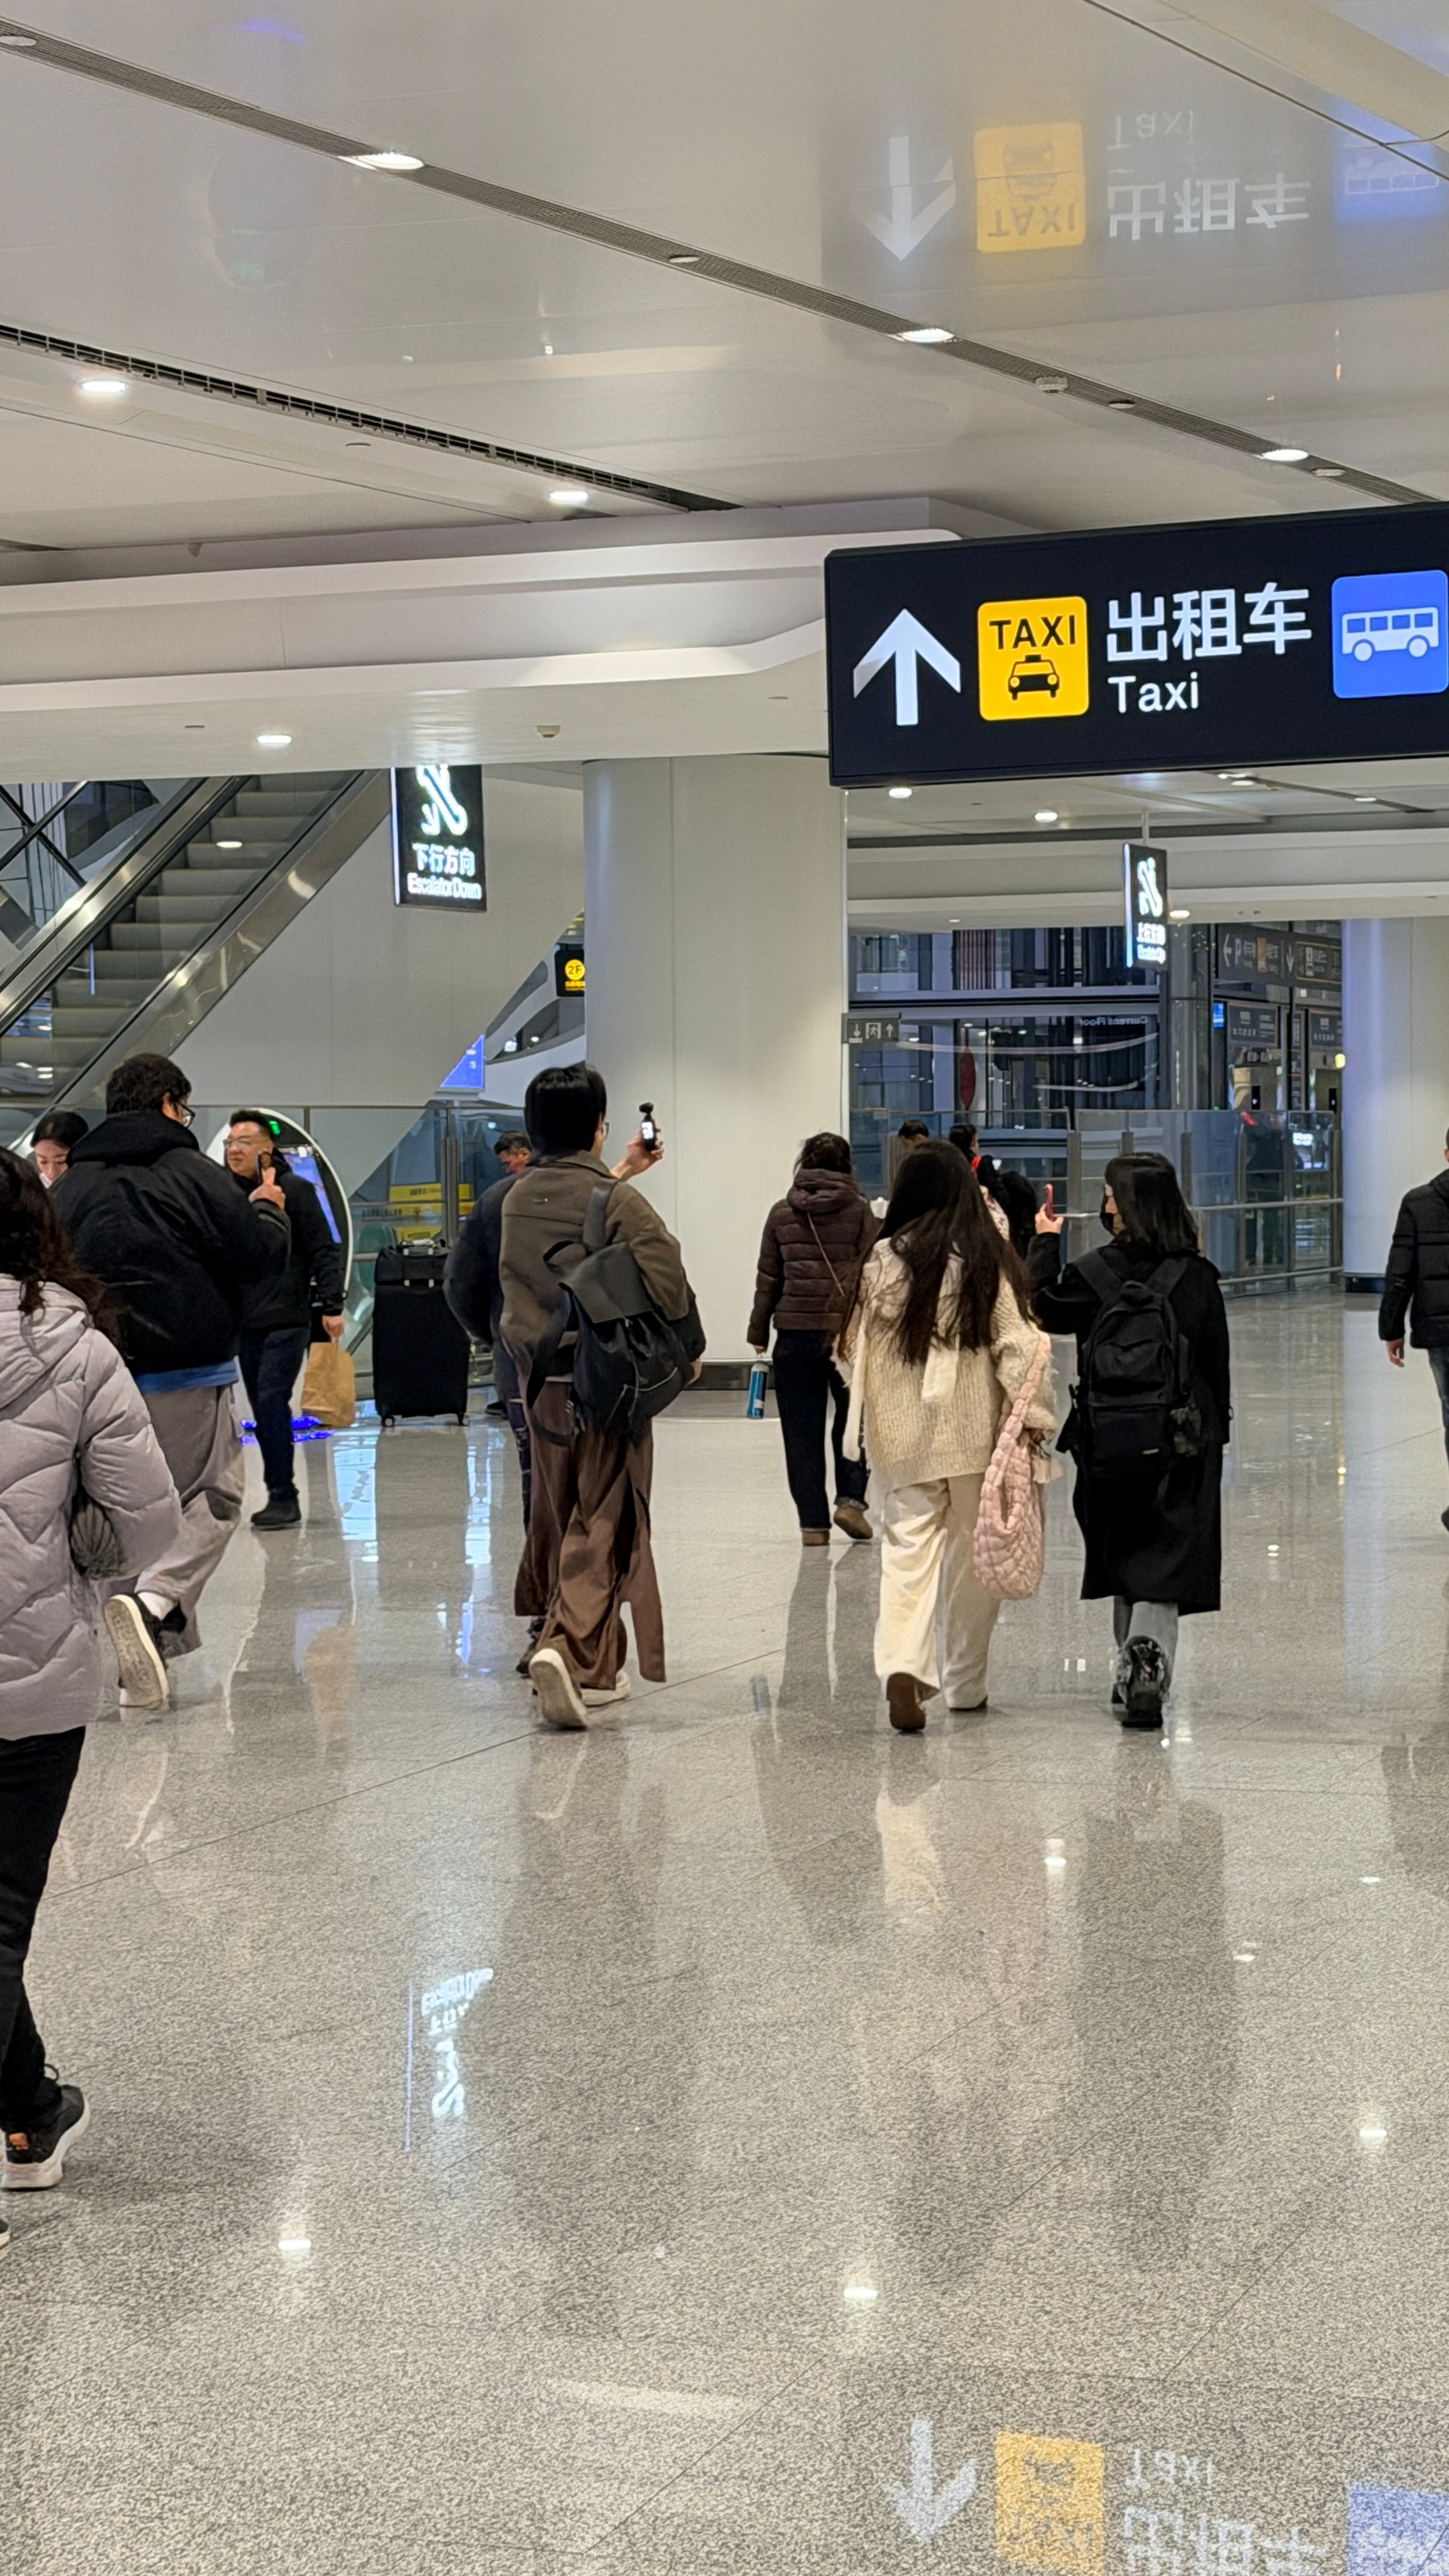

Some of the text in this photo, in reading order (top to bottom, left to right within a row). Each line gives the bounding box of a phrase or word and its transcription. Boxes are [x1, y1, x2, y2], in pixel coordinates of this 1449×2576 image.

[989, 615, 1077, 650] TAXI
[1107, 582, 1312, 662] 出租车
[1107, 671, 1198, 713] Taxi
[411, 843, 475, 877] 下行方向
[407, 872, 452, 897] Escalator
[568, 965, 582, 975] 2F
